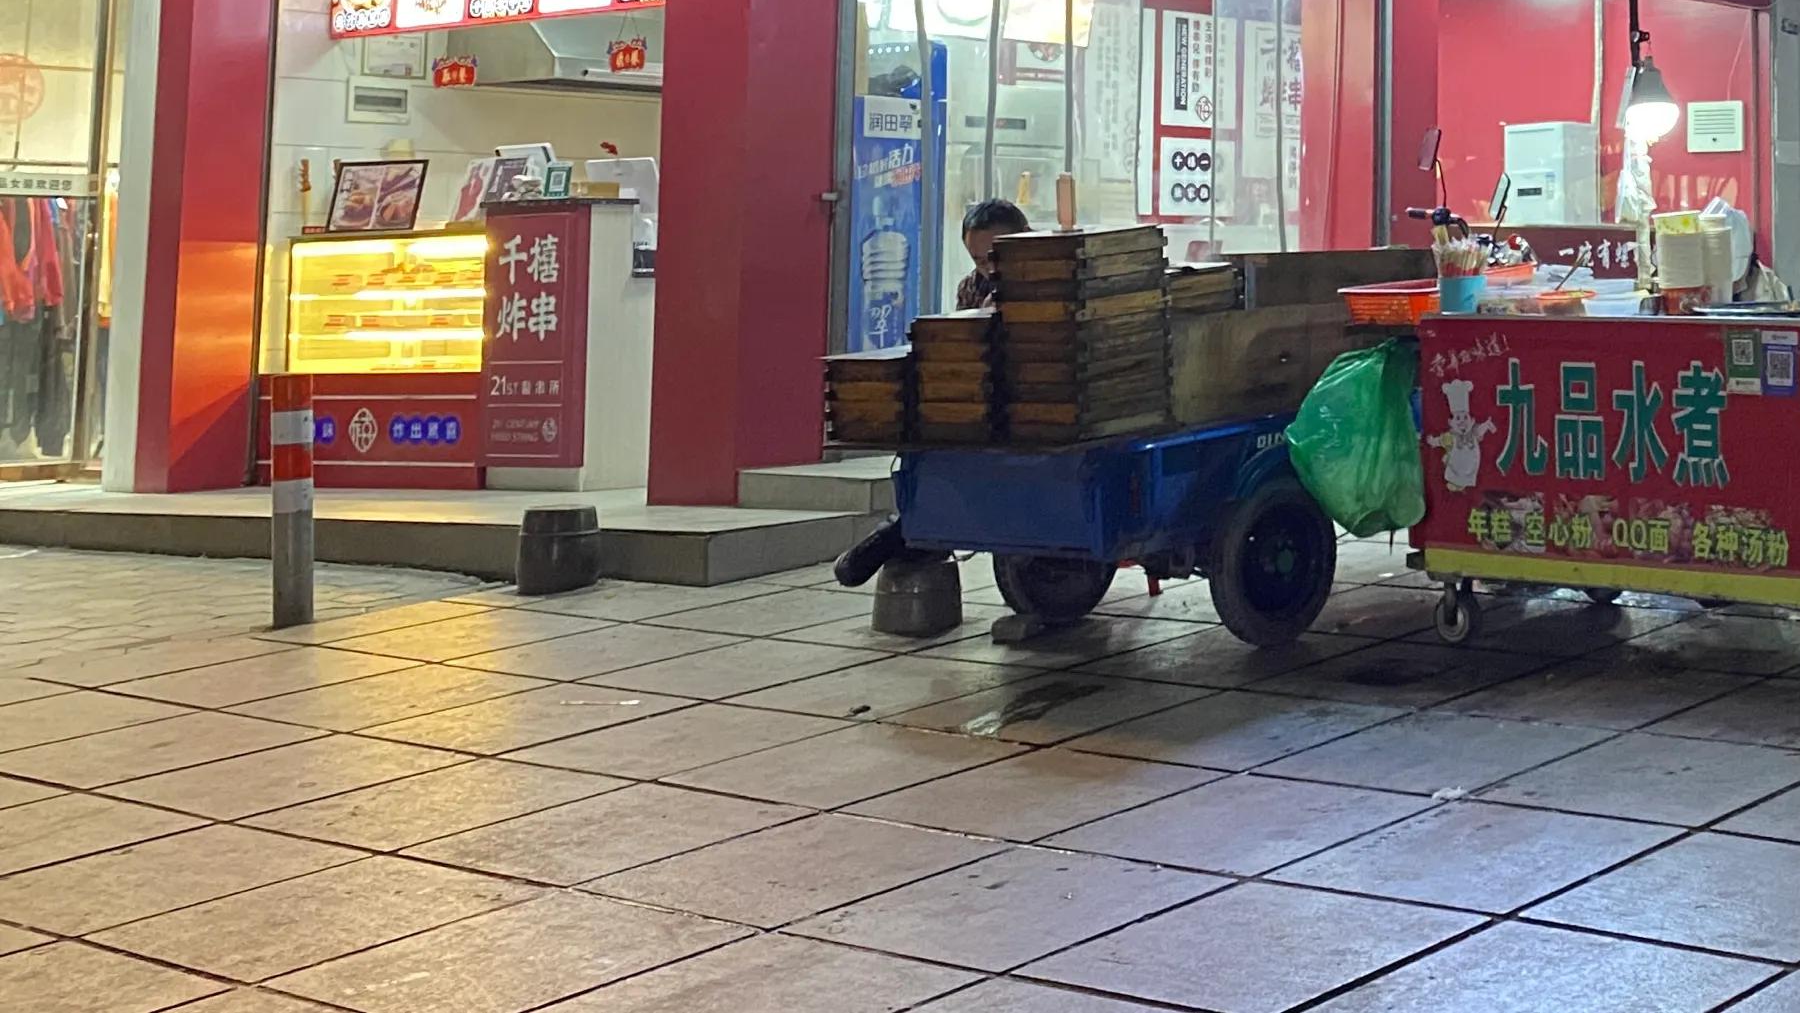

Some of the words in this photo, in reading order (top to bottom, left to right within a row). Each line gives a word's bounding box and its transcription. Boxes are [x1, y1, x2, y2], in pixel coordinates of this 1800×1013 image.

[500, 233, 560, 286] 千禧
[496, 291, 558, 342] 炸串
[1496, 357, 1731, 488] 九品水煮
[1468, 508, 1512, 544] 年糕
[1524, 510, 1594, 551] 空心粉
[1612, 517, 1670, 555] QQ面
[1692, 520, 1790, 567] 各种汤粉
